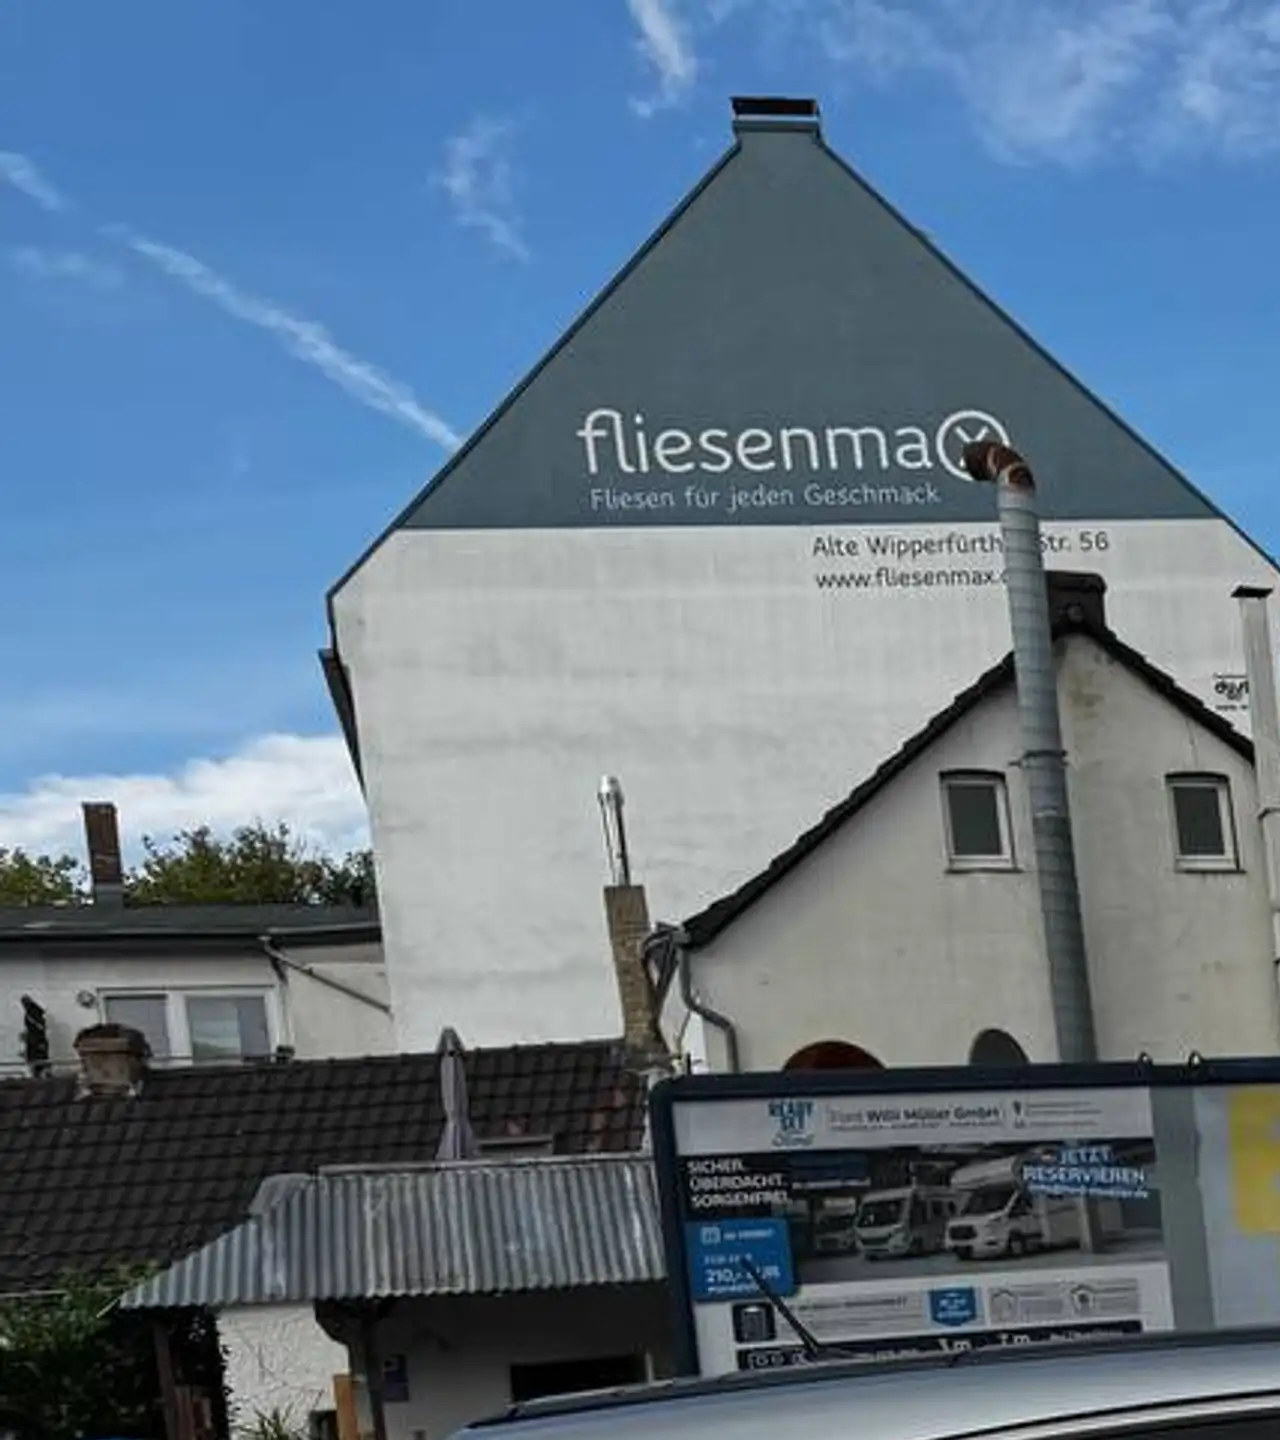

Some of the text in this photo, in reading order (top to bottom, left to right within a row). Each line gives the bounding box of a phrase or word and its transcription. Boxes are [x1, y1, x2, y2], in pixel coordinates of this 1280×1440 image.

[590, 481, 941, 514] Fliesen für jeden Geschmack
[812, 536, 860, 556] Alte
[1079, 531, 1110, 551] 56
